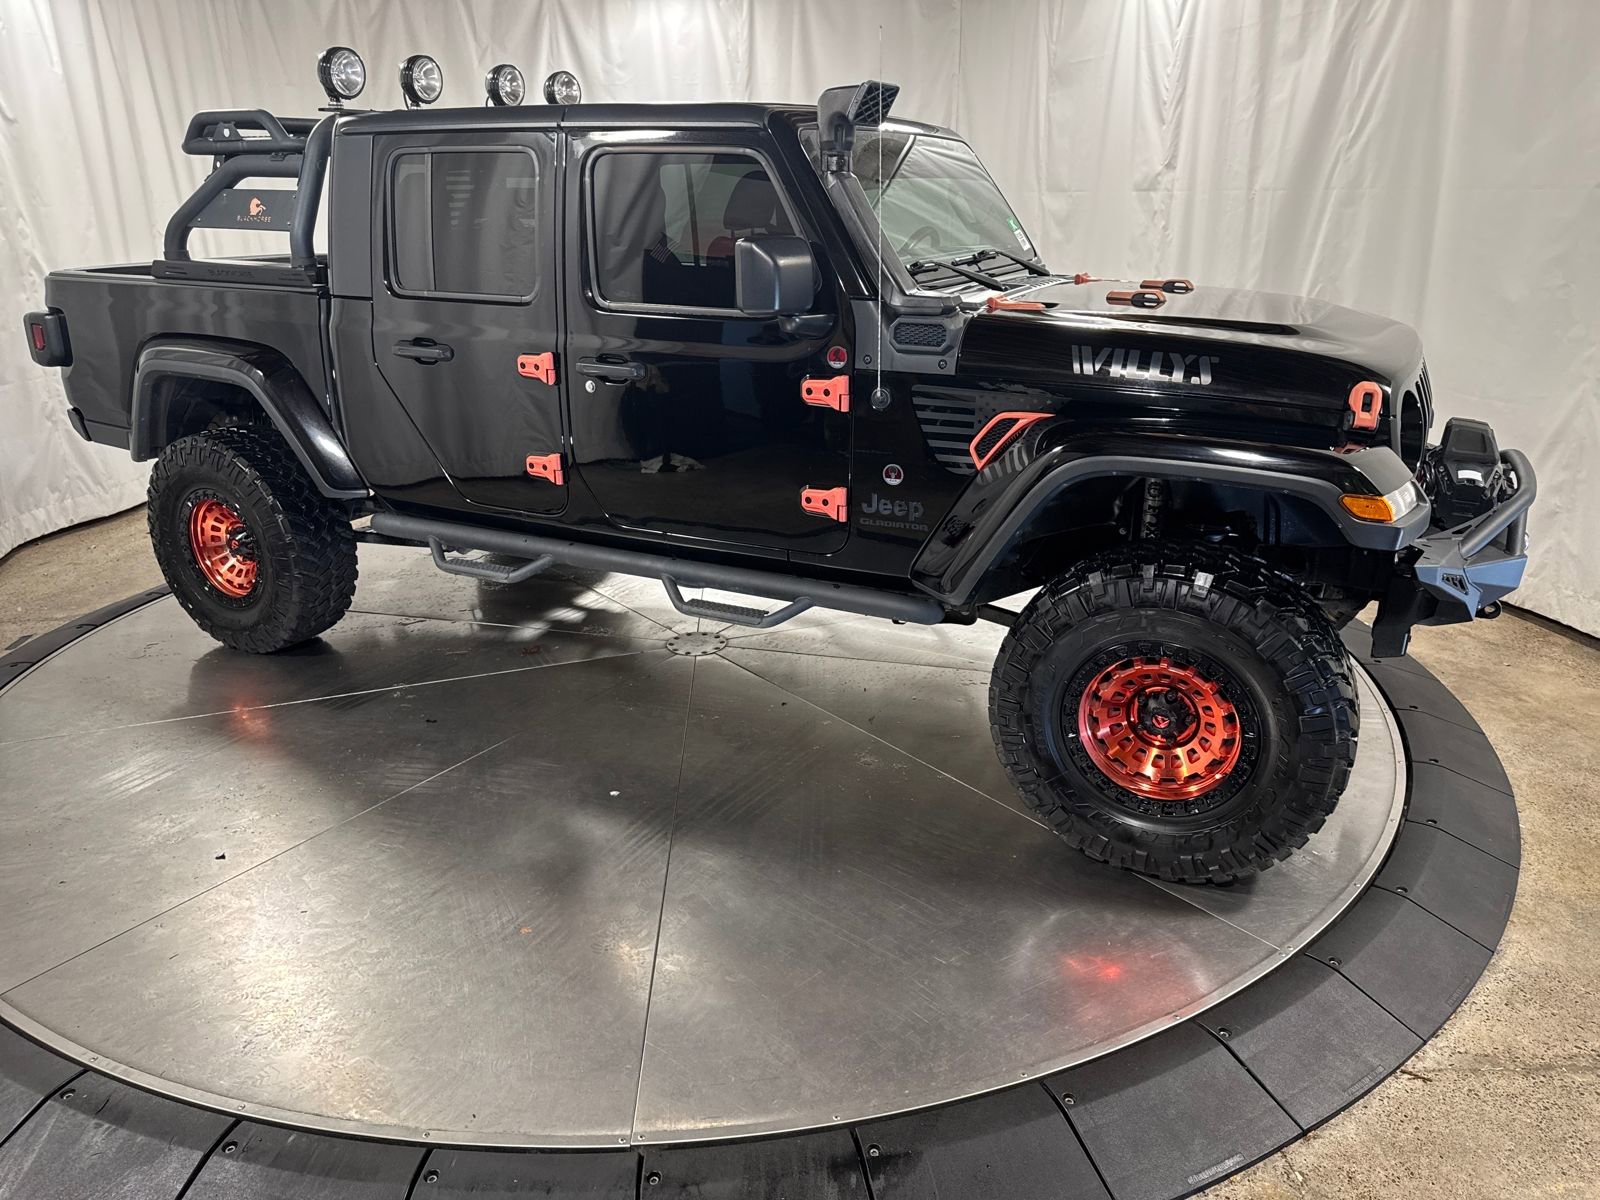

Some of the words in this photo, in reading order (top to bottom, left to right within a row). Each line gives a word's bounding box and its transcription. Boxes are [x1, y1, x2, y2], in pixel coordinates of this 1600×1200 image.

[1072, 345, 1220, 385] WILLYS
[861, 493, 924, 521] Jeep
[860, 517, 929, 532] GLADIATOR
